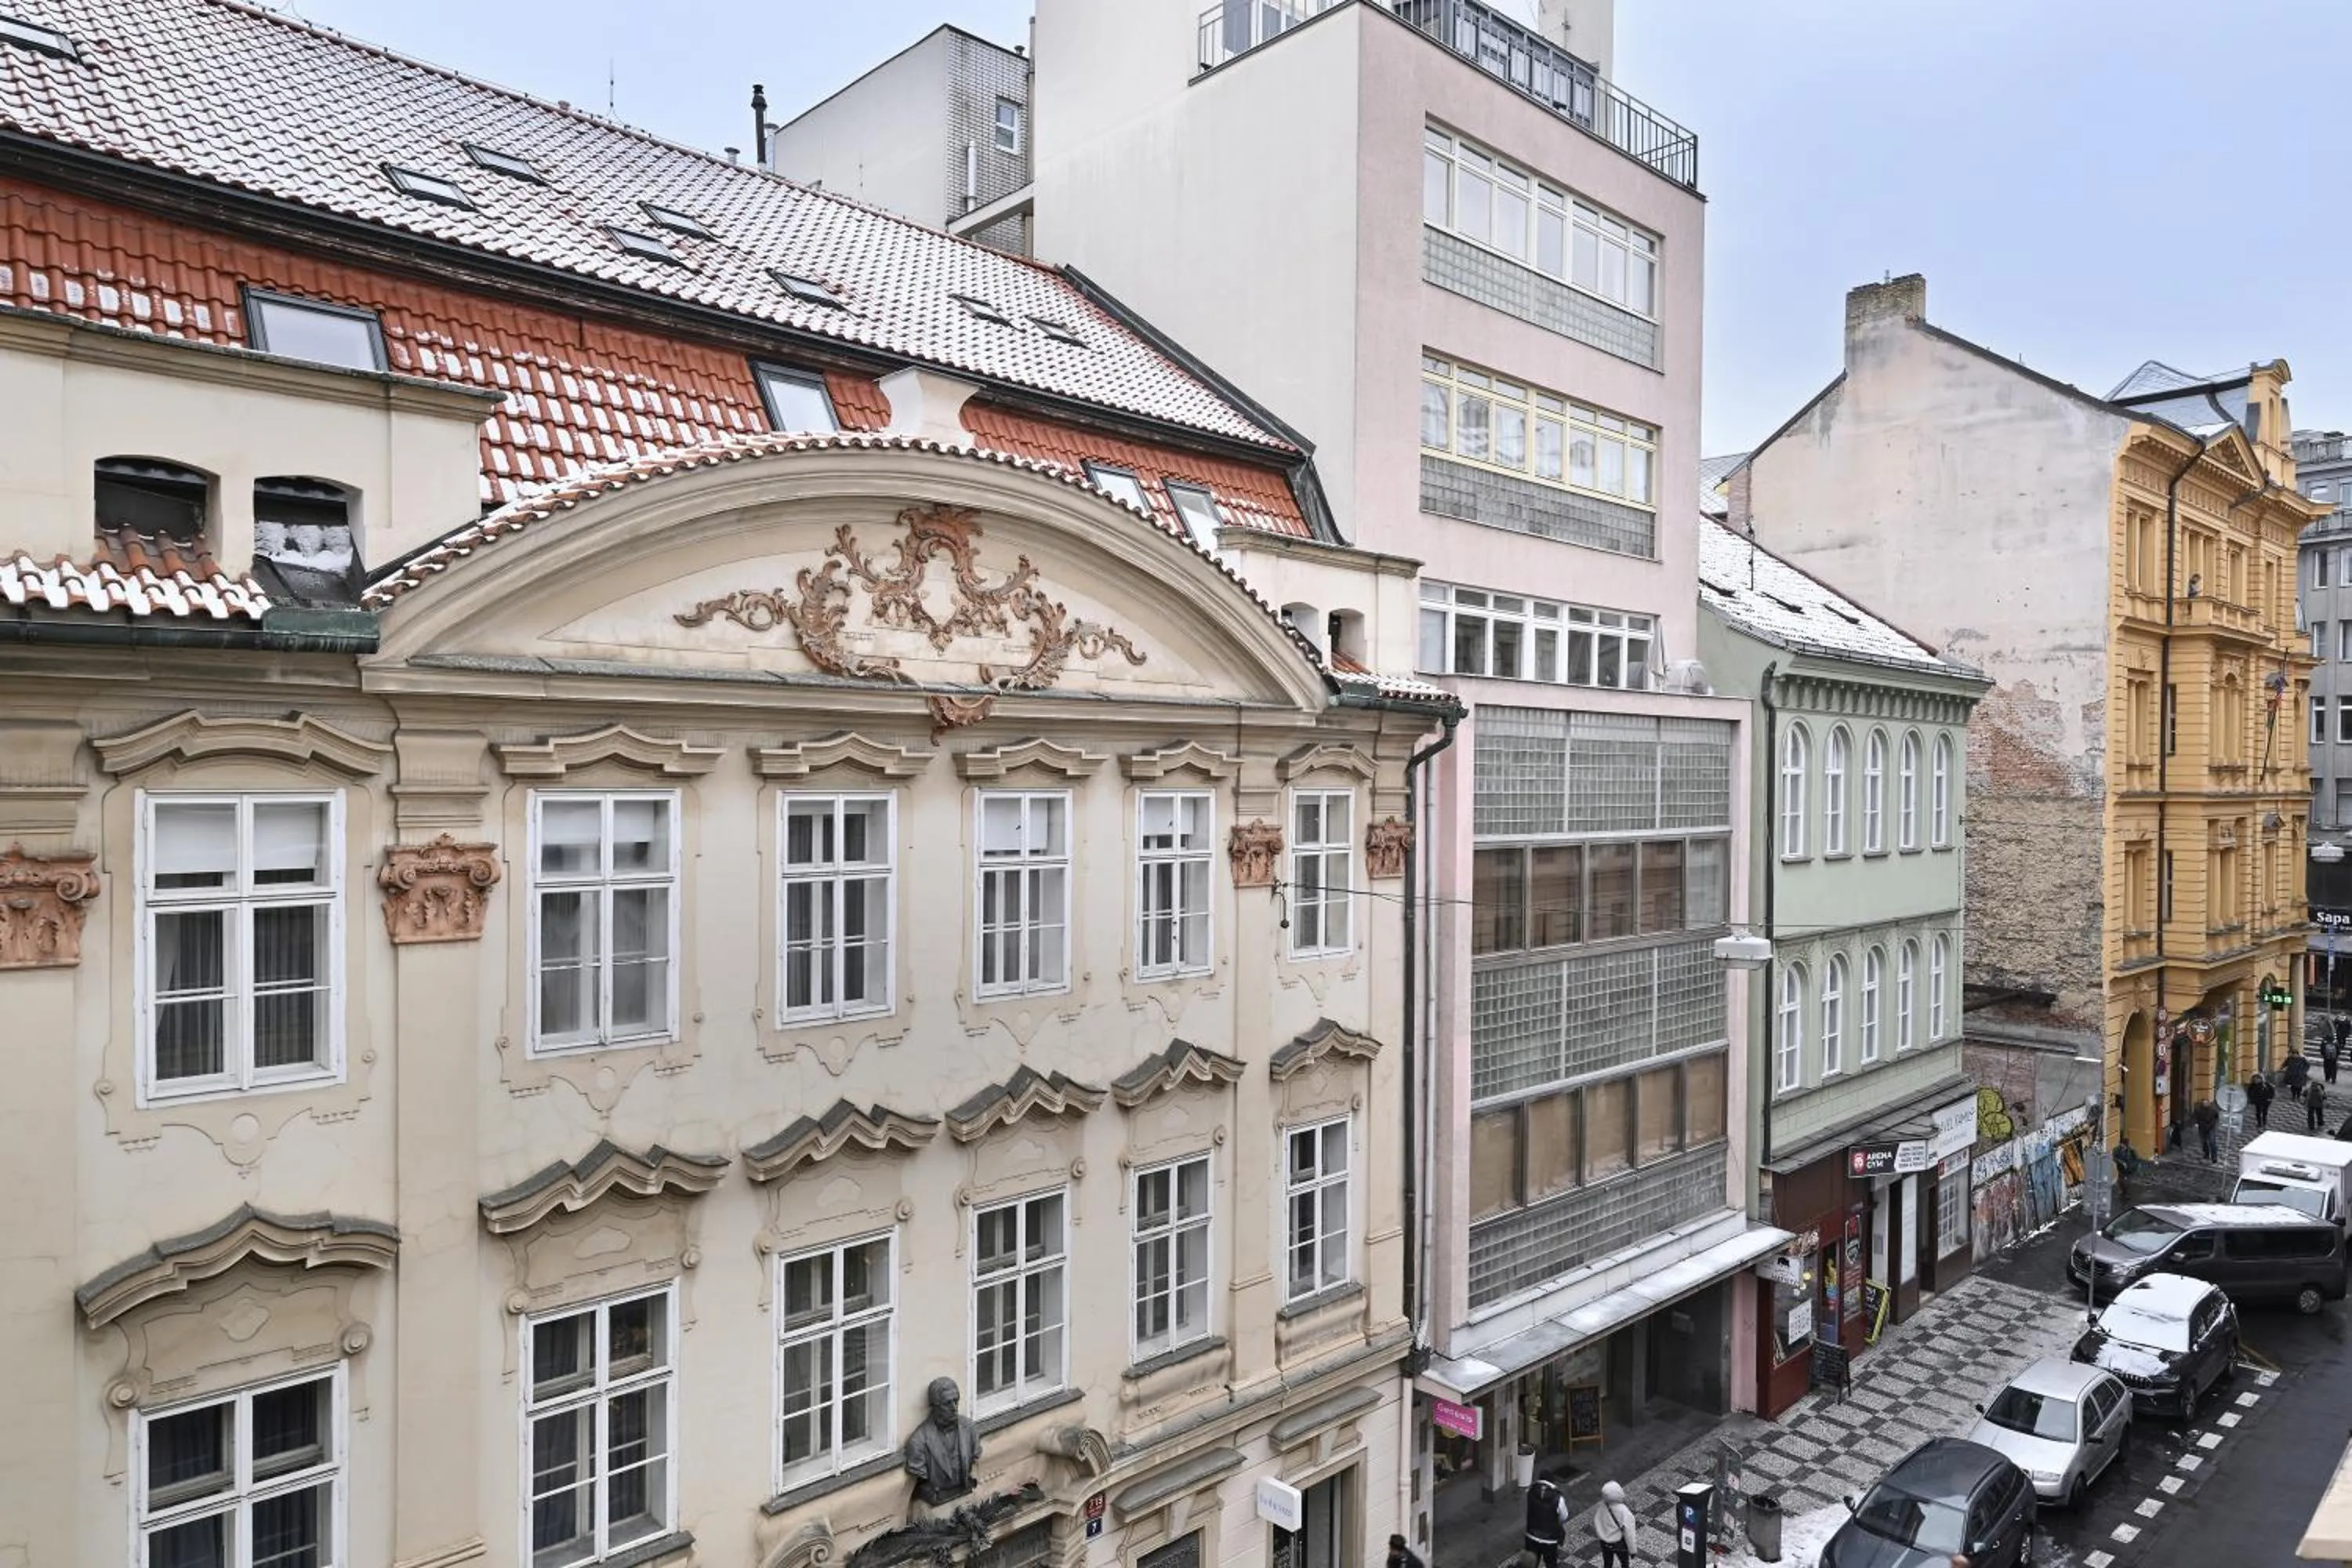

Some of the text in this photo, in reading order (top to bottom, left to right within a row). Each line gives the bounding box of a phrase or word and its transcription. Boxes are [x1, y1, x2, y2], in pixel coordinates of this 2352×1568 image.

[2317, 912, 2350, 925] Sapa
[1866, 1151, 1892, 1160] ARENA
[1866, 1160, 1884, 1169] GYM
[1685, 1506, 1694, 1519] P
